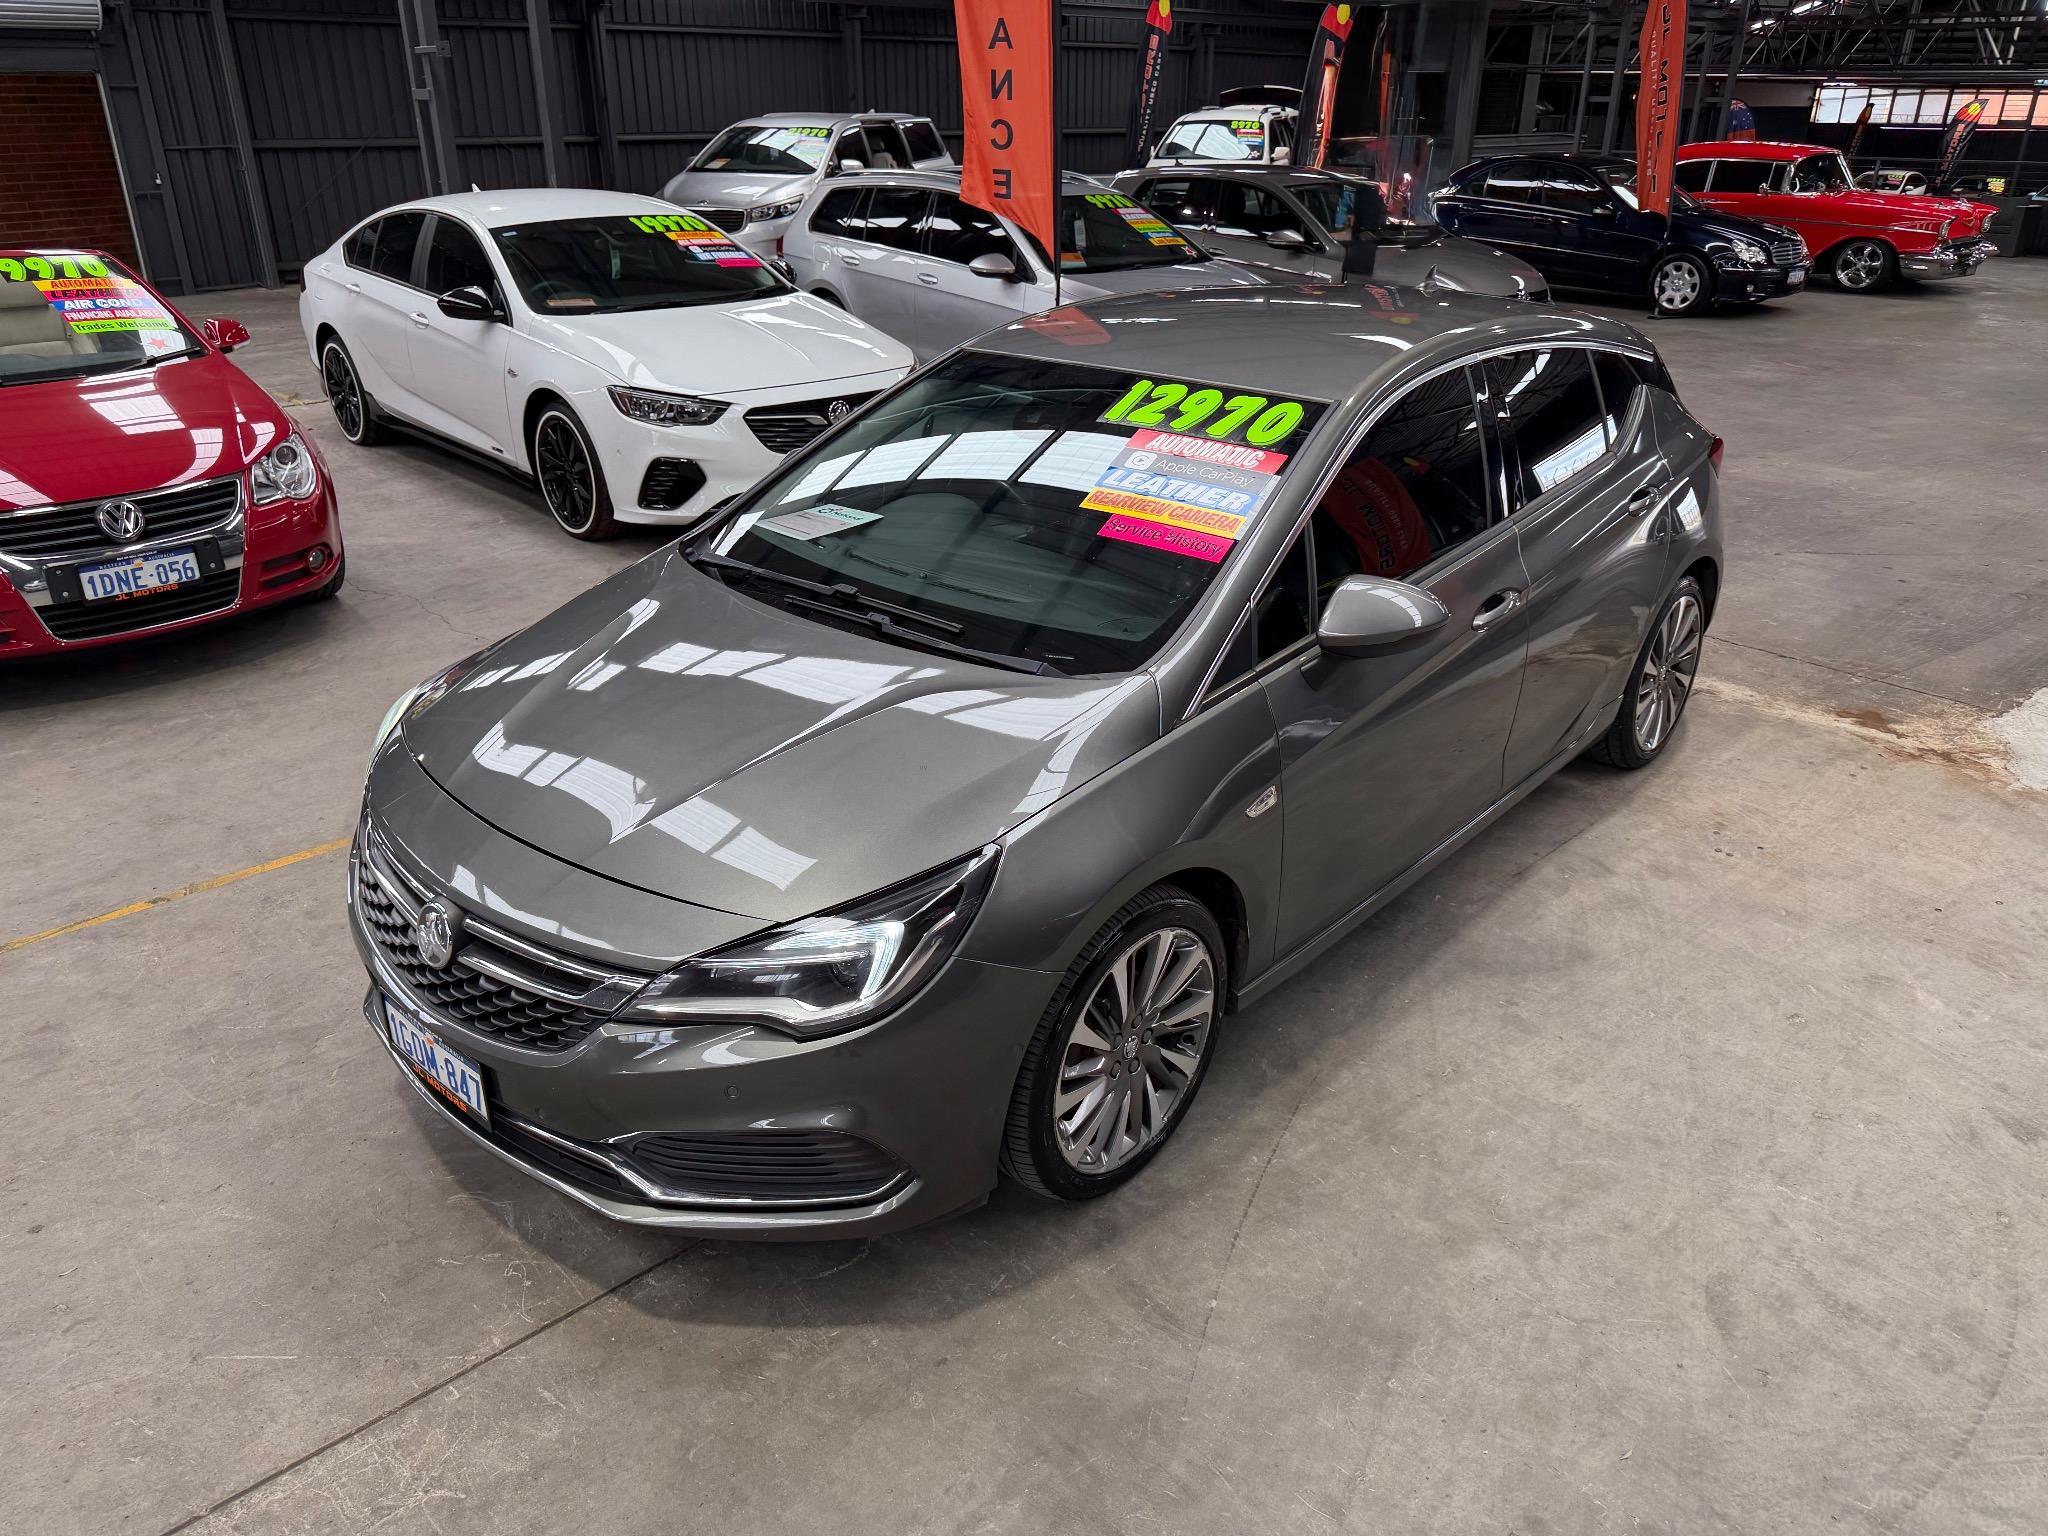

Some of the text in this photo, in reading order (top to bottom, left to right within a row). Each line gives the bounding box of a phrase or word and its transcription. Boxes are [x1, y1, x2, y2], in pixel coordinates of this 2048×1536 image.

[1084, 194, 1135, 209] 9970
[628, 215, 709, 234] 19970
[0, 256, 109, 282] 9970
[64, 299, 95, 311] AIR
[65, 308, 162, 321] FINANCING AVAILABLE
[74, 320, 168, 332] Trades Welcome
[1103, 379, 1304, 446] 12970
[1146, 433, 1266, 469] AUTOMATIC
[1154, 459, 1255, 487] Apple CarPlay
[1102, 469, 1251, 513] LEATHER
[1087, 490, 1241, 532] REARVIEW CAMERA
[1106, 518, 1225, 557] Service History
[133, 583, 179, 598] MOTORS
[412, 1063, 468, 1113] JL MOTORS
